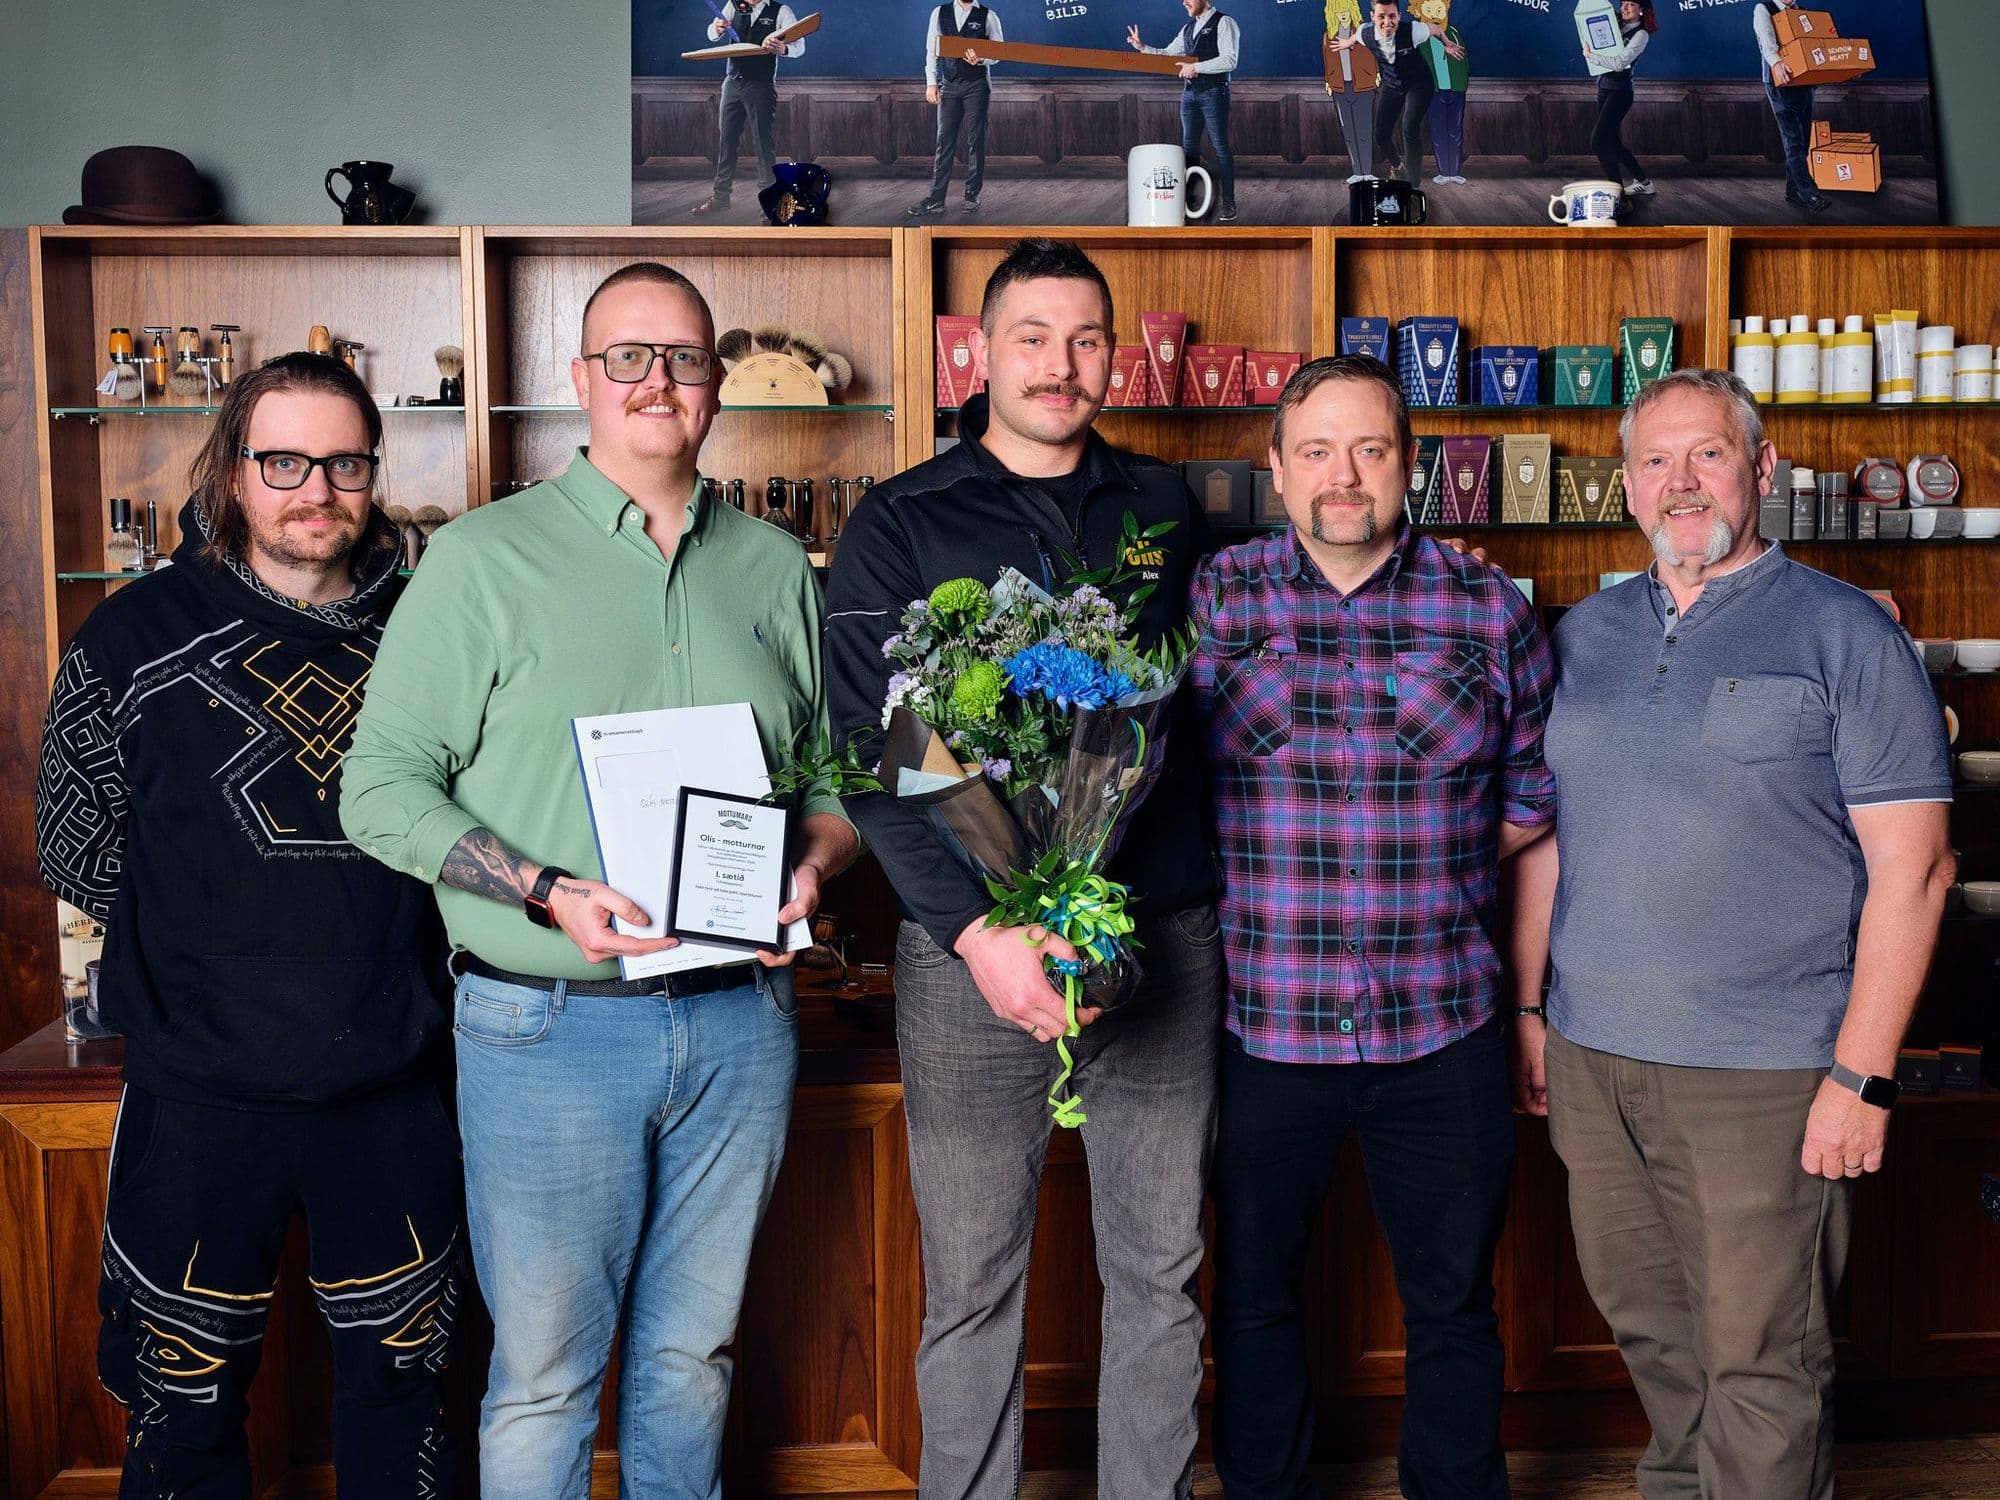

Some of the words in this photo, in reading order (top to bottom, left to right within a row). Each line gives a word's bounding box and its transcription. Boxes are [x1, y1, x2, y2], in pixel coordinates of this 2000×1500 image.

[1142, 571, 1159, 580] Alex
[718, 810, 753, 822] MOTTUMARS
[722, 839, 766, 851] motturnar
